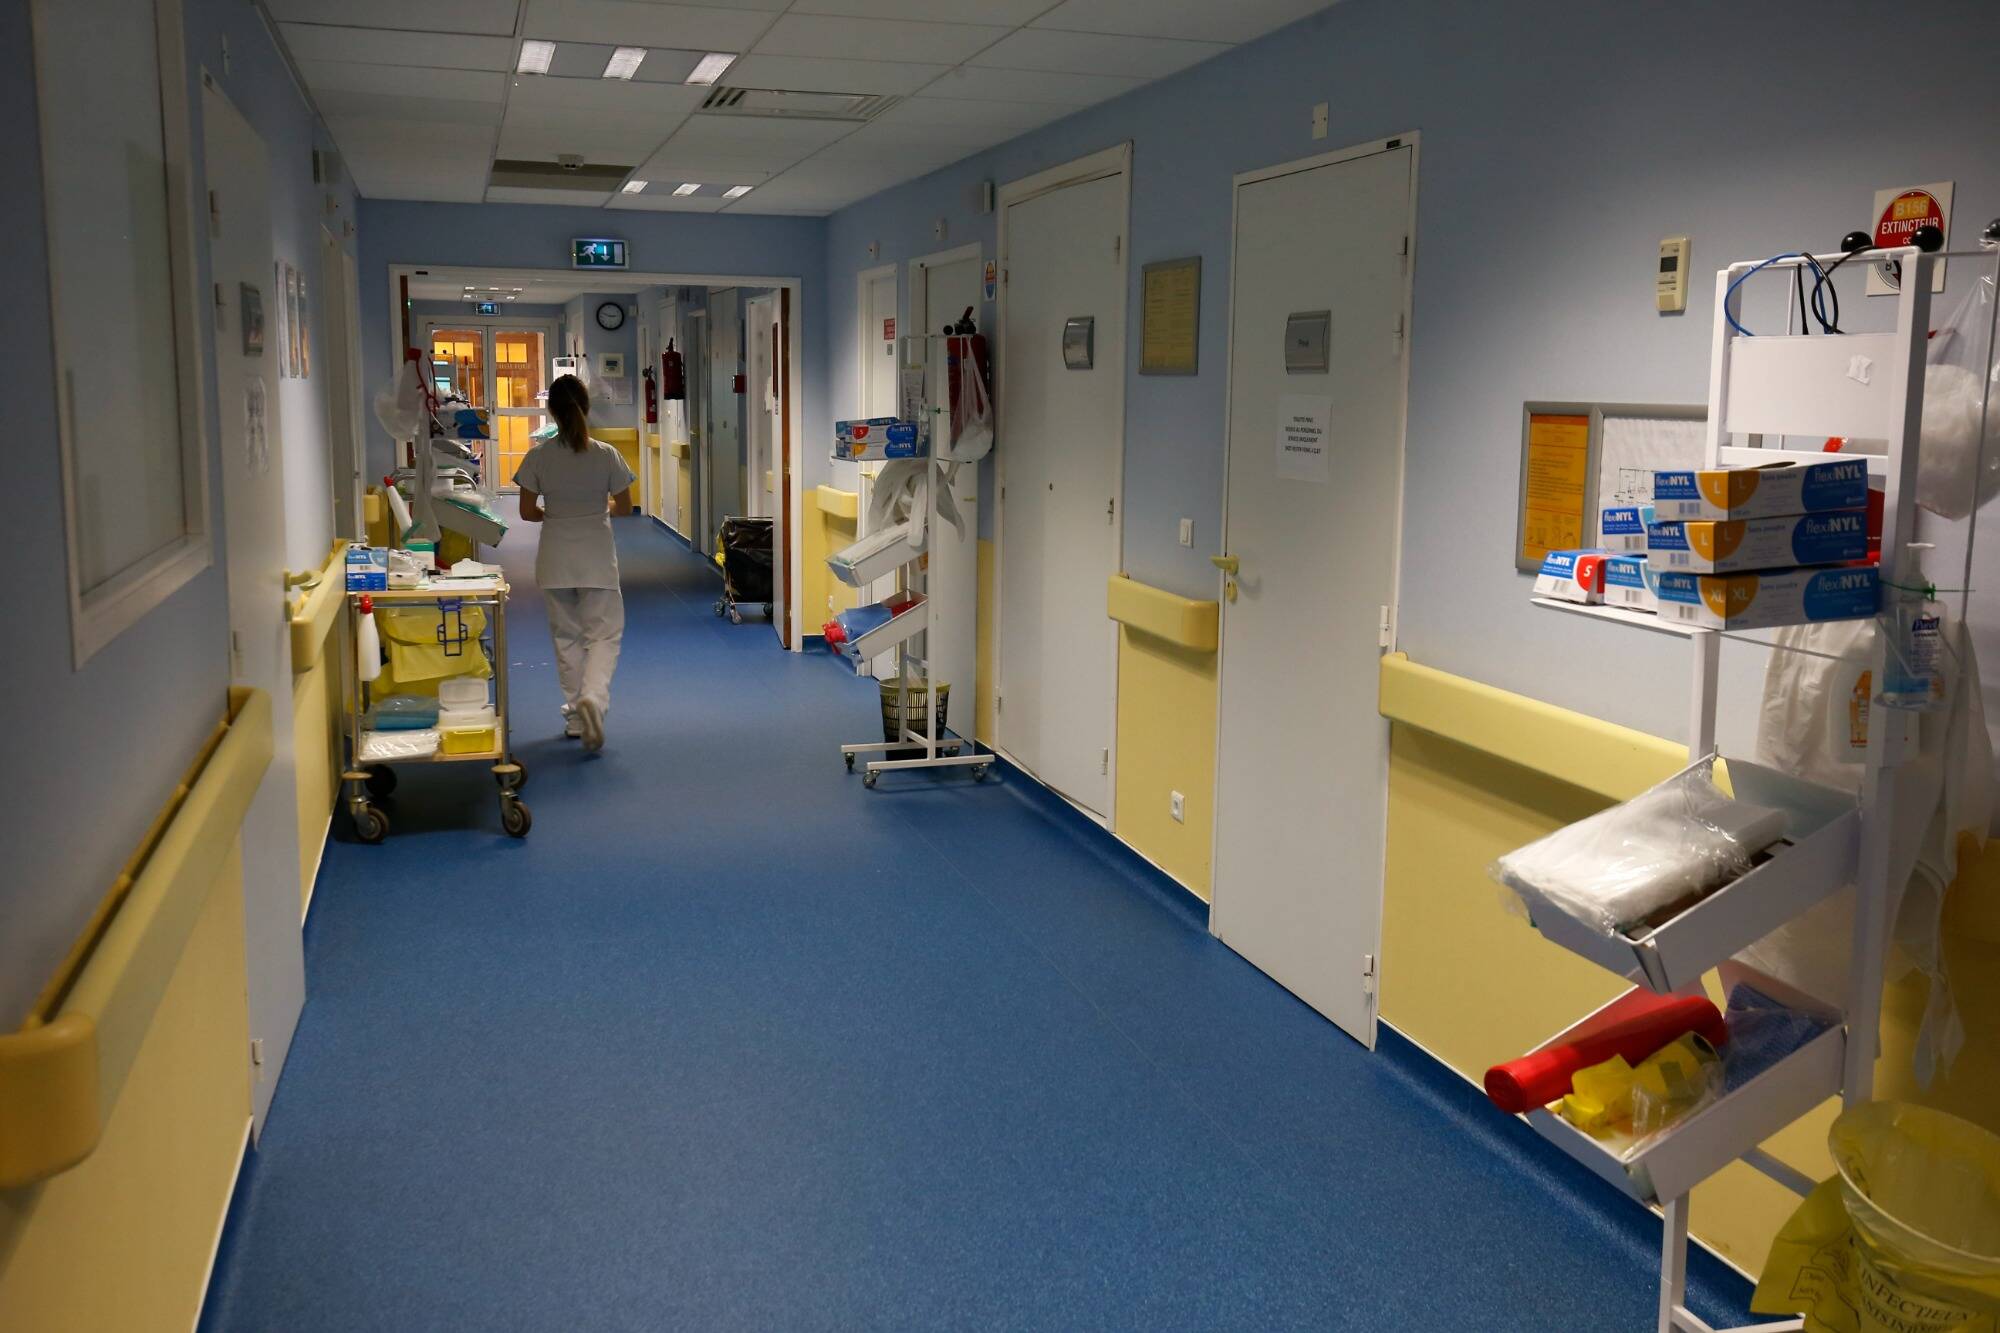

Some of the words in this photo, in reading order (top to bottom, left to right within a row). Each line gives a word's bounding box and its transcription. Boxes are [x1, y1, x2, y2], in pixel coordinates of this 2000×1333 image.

[1881, 217, 1939, 234] EXTINCTEUR
[1656, 474, 1690, 486] flexiNYL
[1814, 464, 1862, 483] flexiNYL
[1714, 480, 1721, 494] L
[1739, 477, 1746, 489] L
[1604, 511, 1633, 522] flexiNYL
[1648, 526, 1680, 537] flexiNYL
[1806, 516, 1860, 535] flexiNYL
[1702, 533, 1708, 545] L
[1724, 530, 1731, 541] L
[1583, 564, 1593, 578] S
[1818, 573, 1871, 592] flexiNYL
[1711, 588, 1724, 604] XL
[1733, 587, 1749, 602] XL
